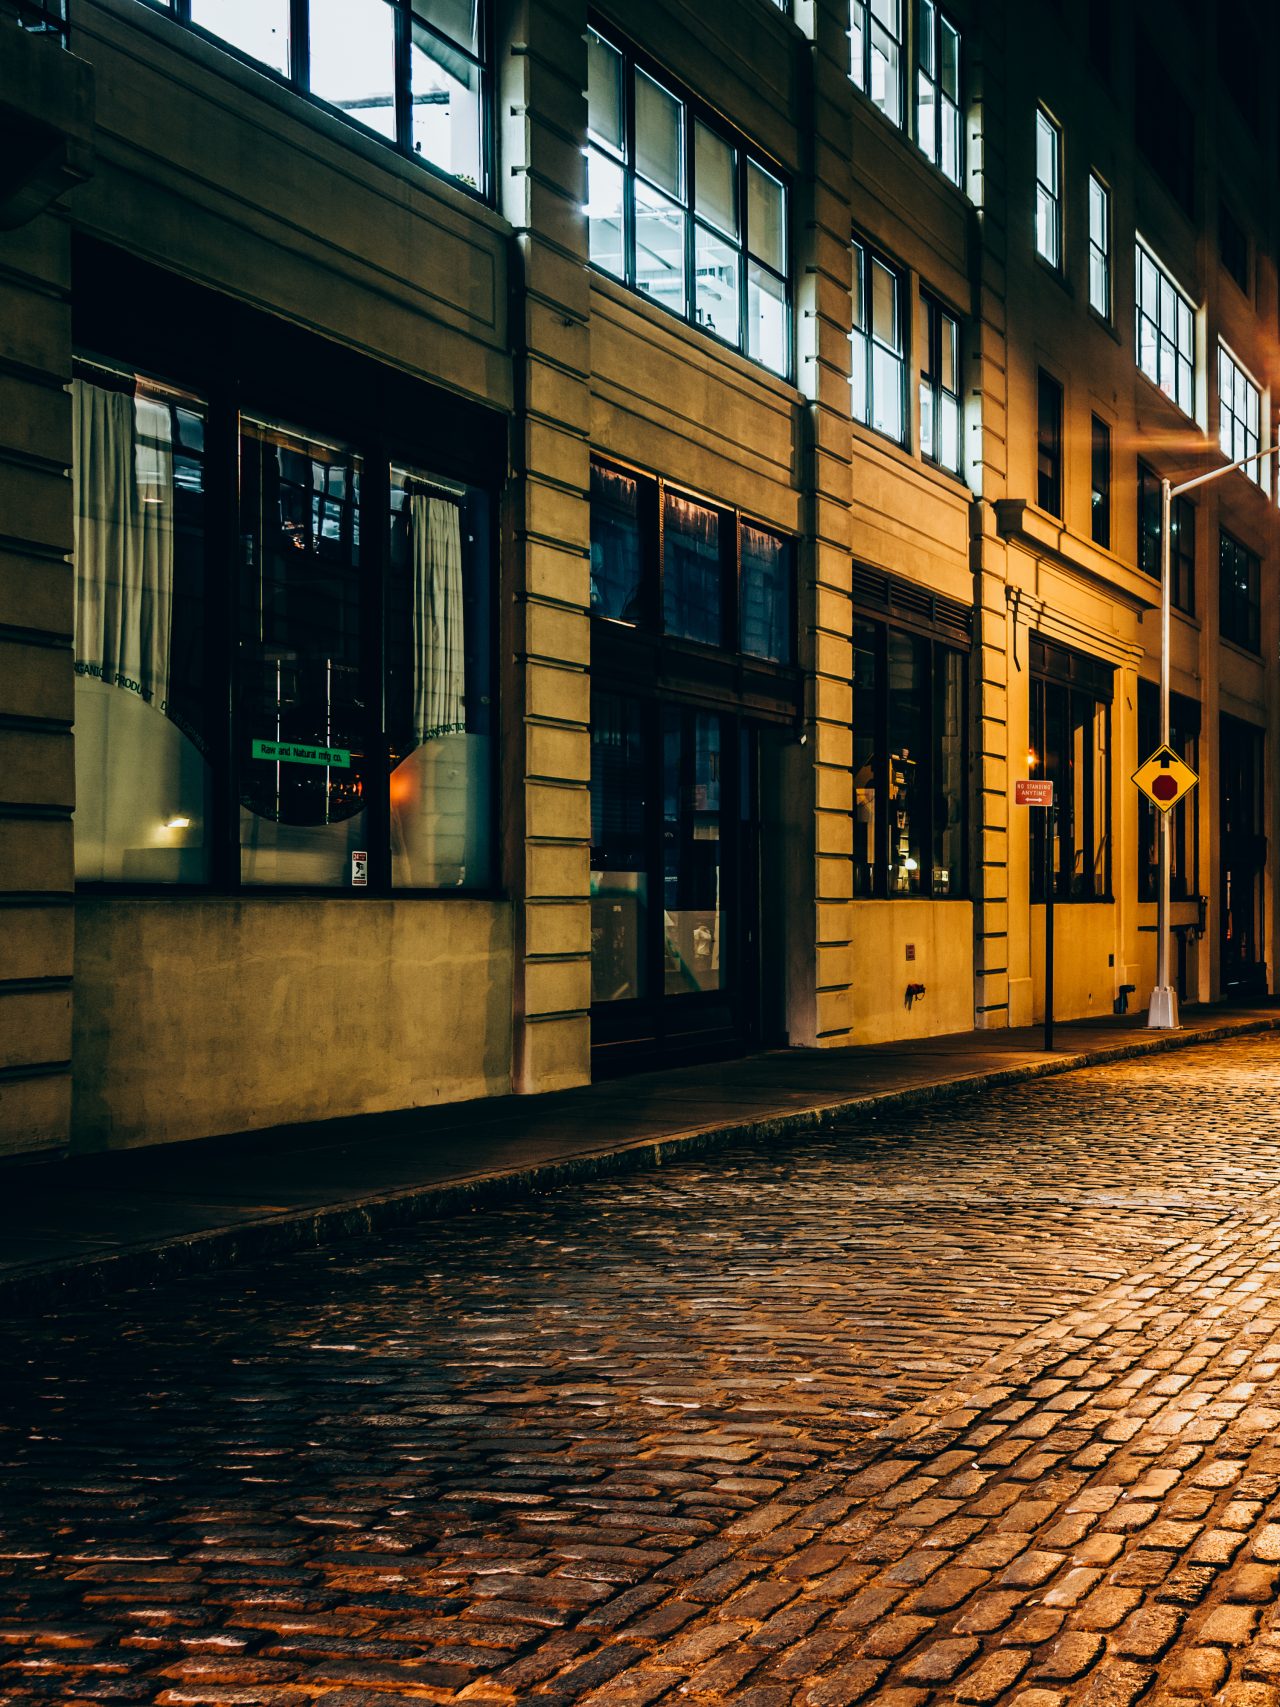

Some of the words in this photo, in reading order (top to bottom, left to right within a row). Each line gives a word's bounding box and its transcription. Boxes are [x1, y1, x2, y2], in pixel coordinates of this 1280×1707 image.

[73, 663, 105, 679] RGANIC
[261, 744, 276, 753] Raw
[279, 747, 290, 756] and
[293, 747, 316, 759] Natural
[318, 751, 331, 762] mfg
